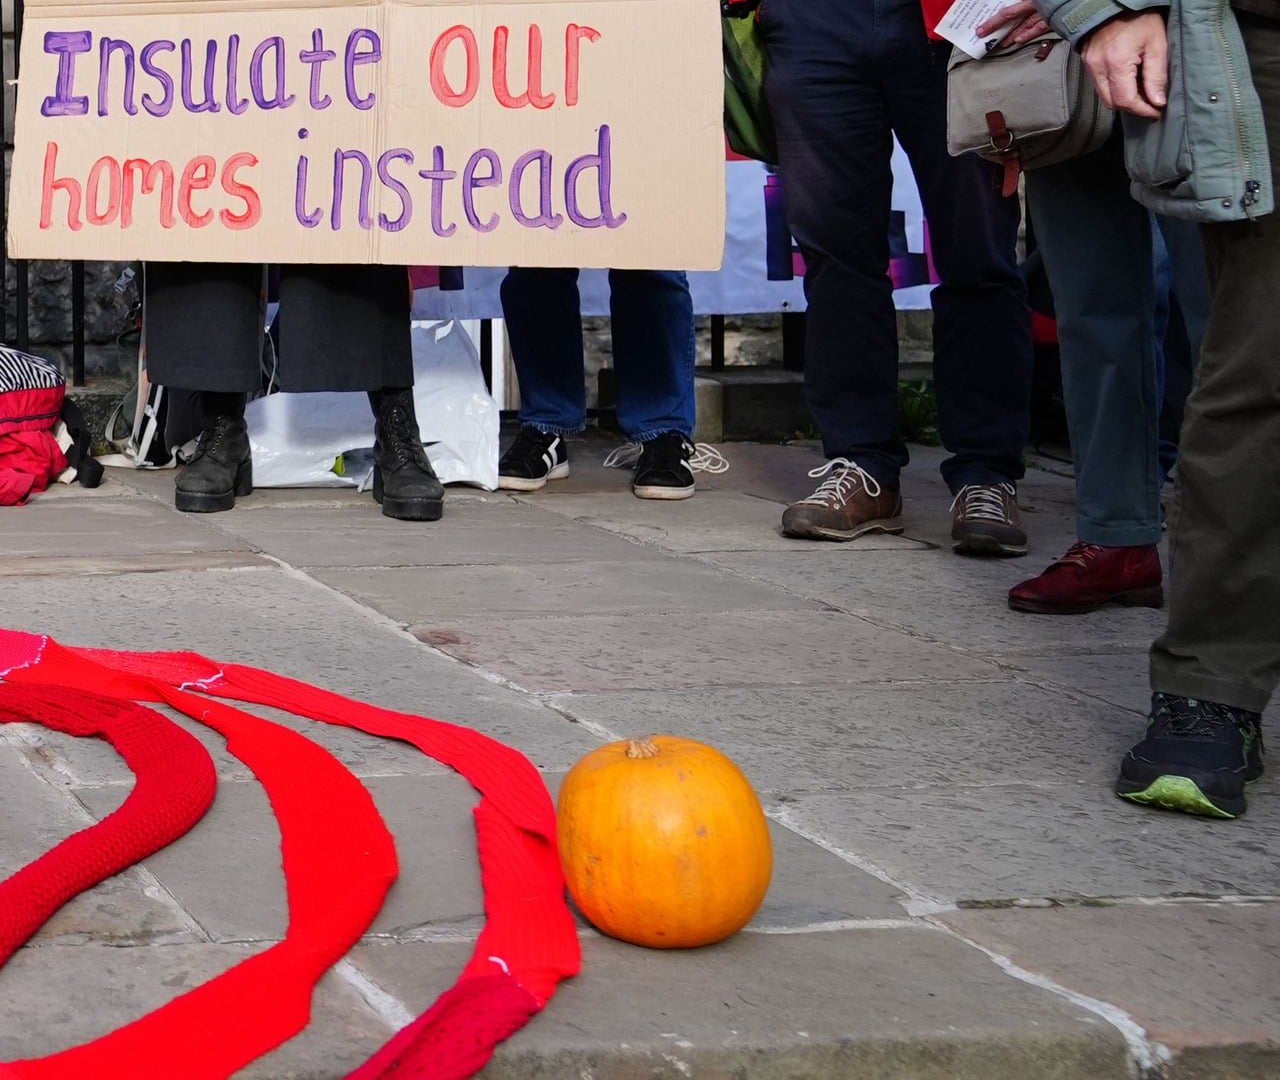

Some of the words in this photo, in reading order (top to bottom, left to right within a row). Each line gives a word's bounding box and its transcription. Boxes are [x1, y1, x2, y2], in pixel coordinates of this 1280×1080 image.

[39, 27, 383, 118] Insulate
[429, 22, 603, 111] our
[39, 141, 264, 231] homes
[295, 122, 628, 237] instead
